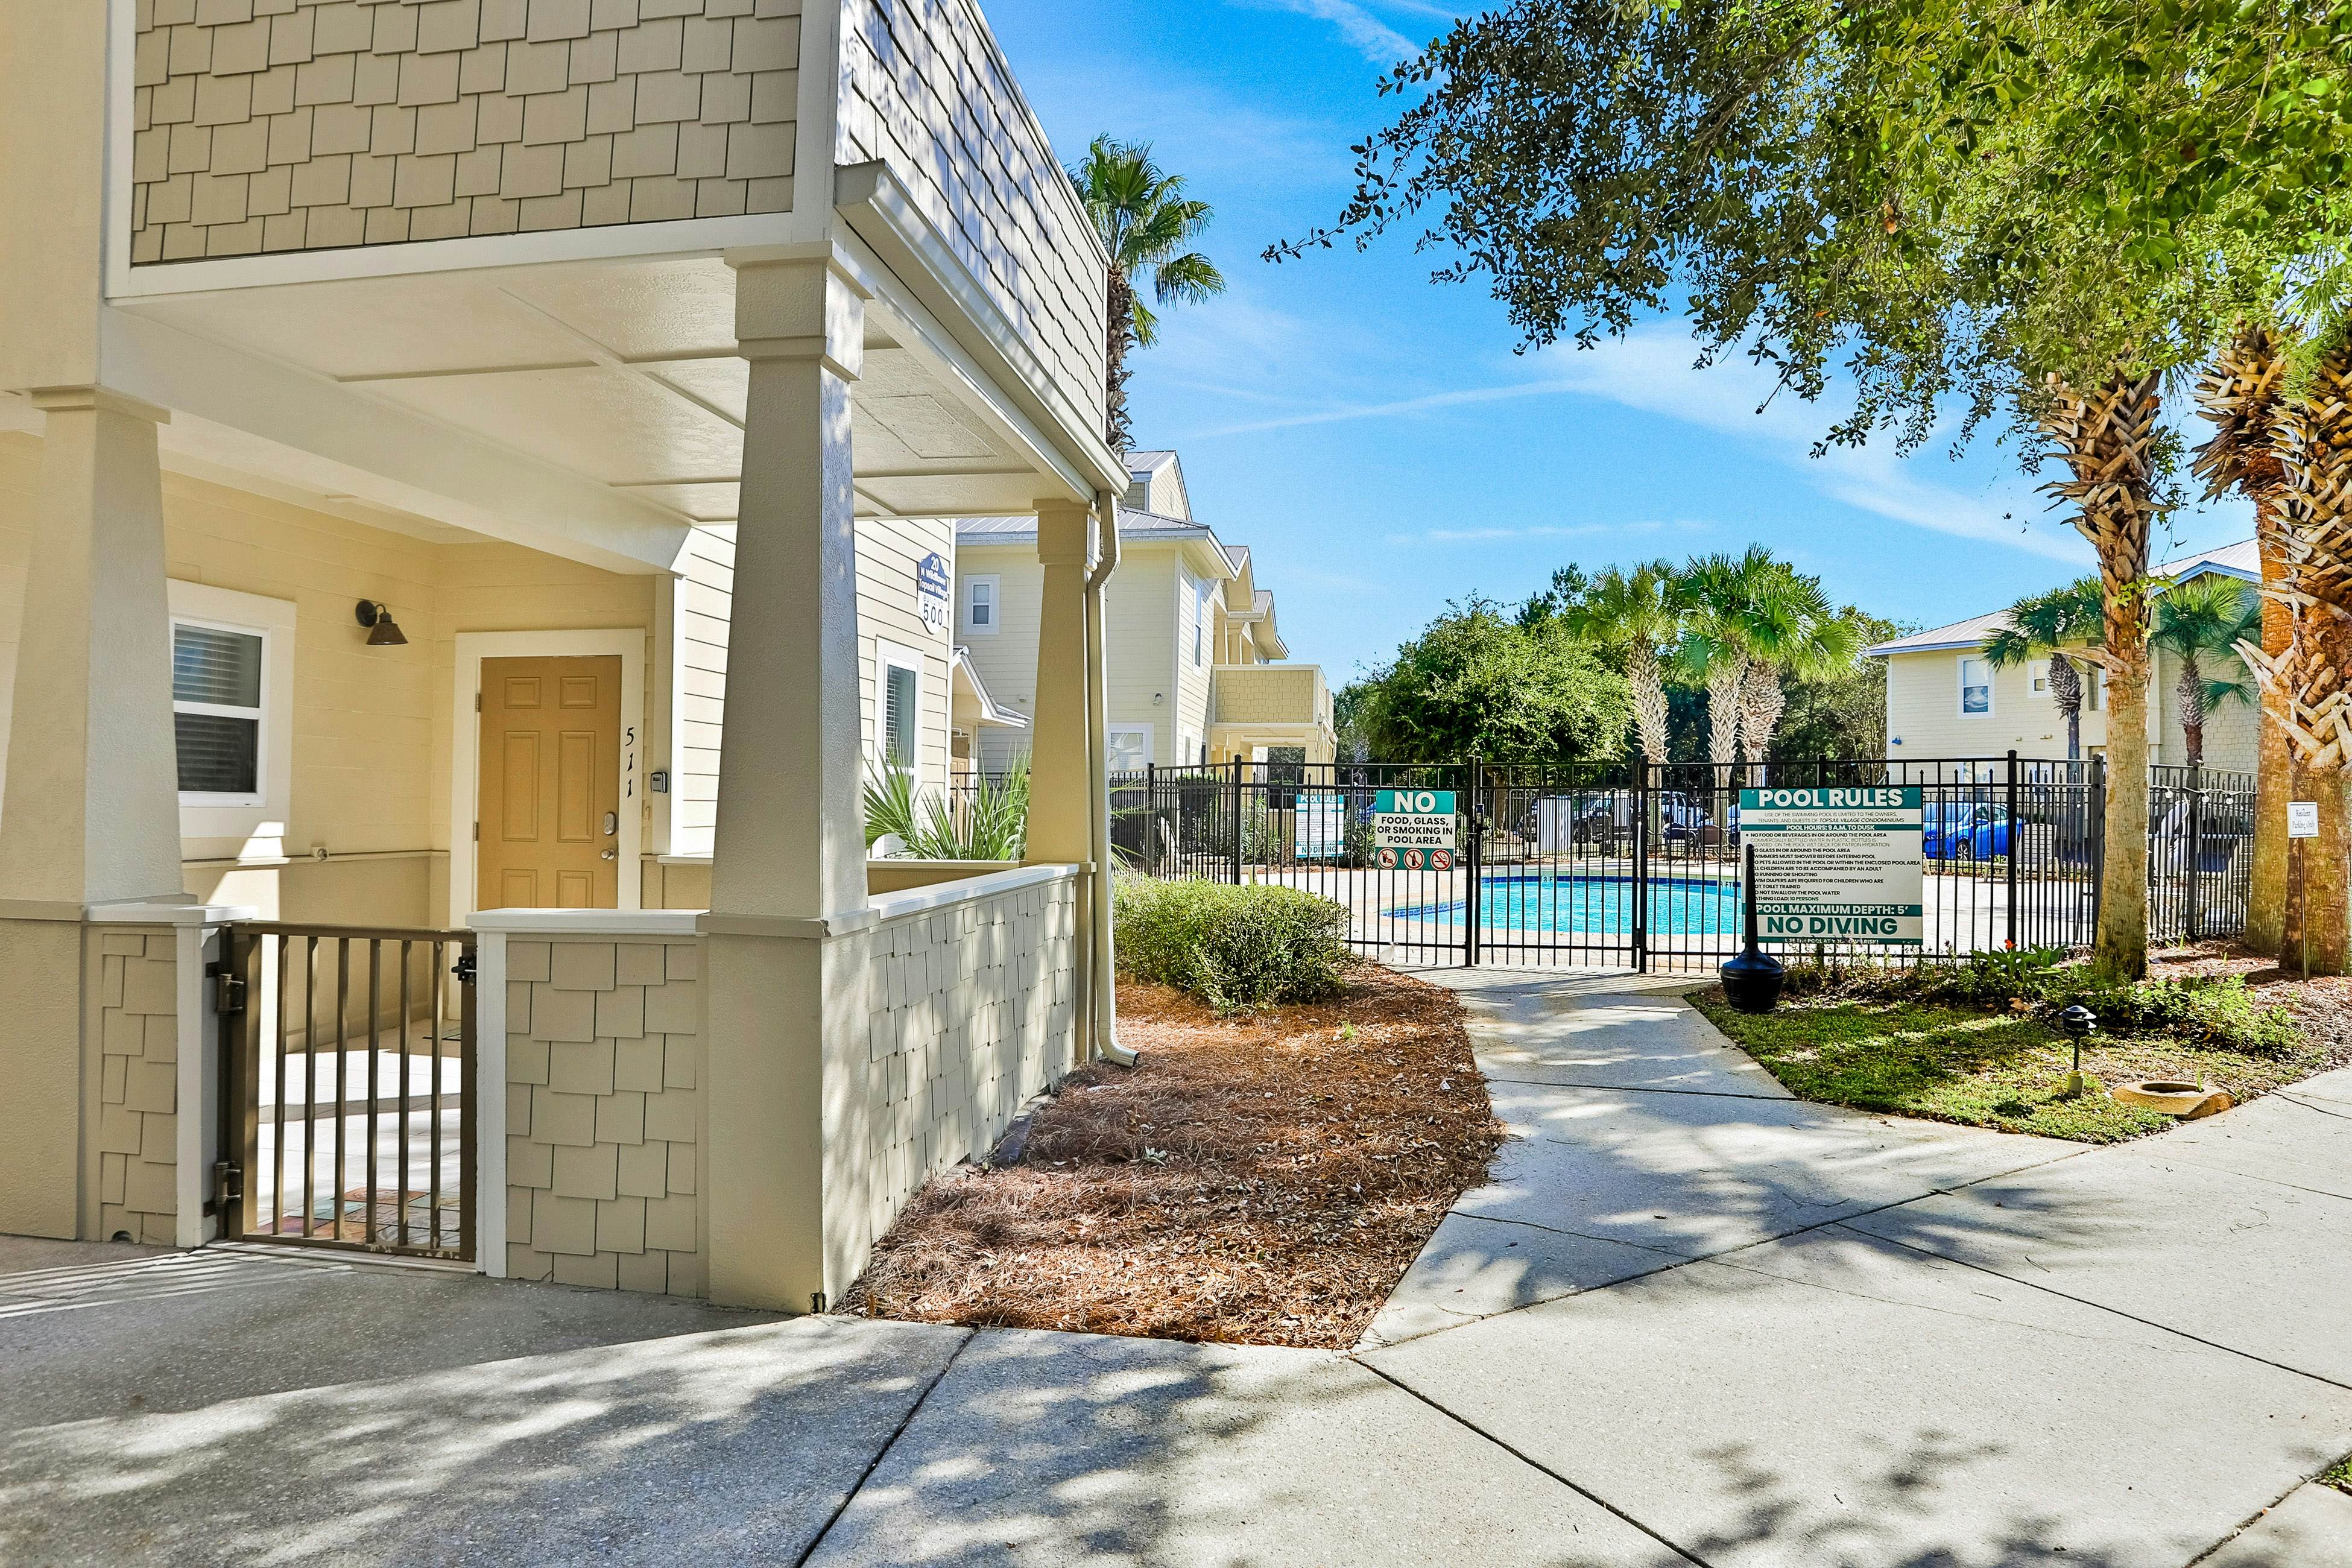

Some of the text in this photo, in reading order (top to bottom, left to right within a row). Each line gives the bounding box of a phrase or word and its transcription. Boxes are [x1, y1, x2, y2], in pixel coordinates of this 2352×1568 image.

[931, 556, 939, 572] 20
[919, 578, 935, 593] Topsail
[924, 603, 942, 625] 500
[625, 727, 634, 798] 511
[1394, 791, 1436, 812] NO
[1759, 789, 1903, 807] POOL RULES
[1381, 817, 1449, 826] FOOD, GLASS,
[1756, 905, 1786, 914] POOL
[1789, 905, 1850, 914] MAXIMUM
[1853, 906, 1894, 914] DEPTH:
[1767, 916, 1898, 935] NO DIVING
